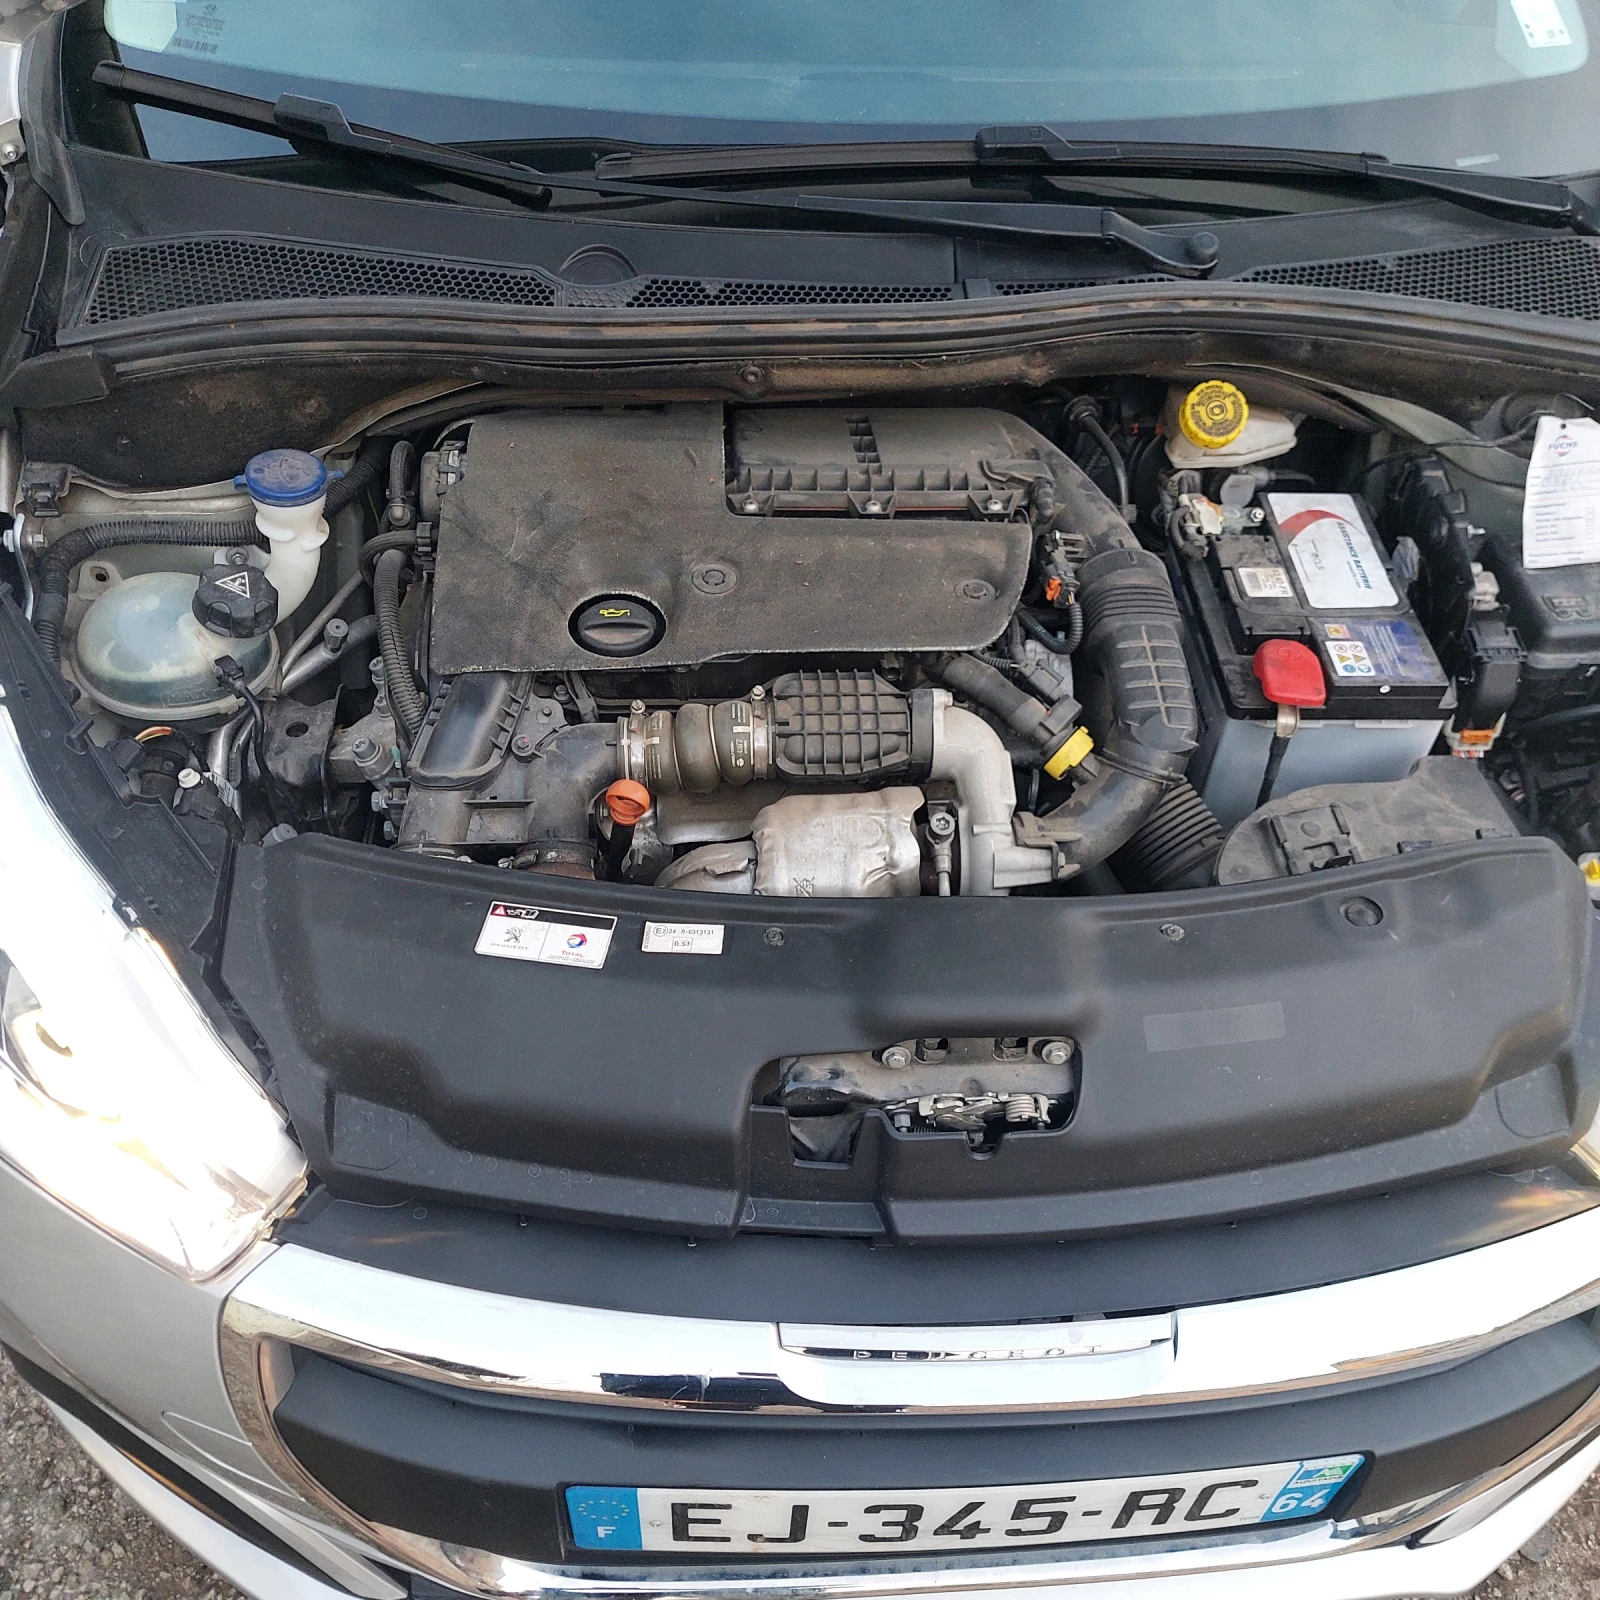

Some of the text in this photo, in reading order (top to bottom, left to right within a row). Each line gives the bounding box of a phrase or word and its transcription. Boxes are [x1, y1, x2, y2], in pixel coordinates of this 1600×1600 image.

[1548, 441, 1578, 451] FUCHS
[490, 942, 529, 950] PEUGEOT
[853, 1344, 1102, 1361] PEUGEOT
[1271, 1488, 1331, 1513] 64
[671, 1479, 1259, 1544] EJ-345-RC
[596, 1525, 617, 1539] F
